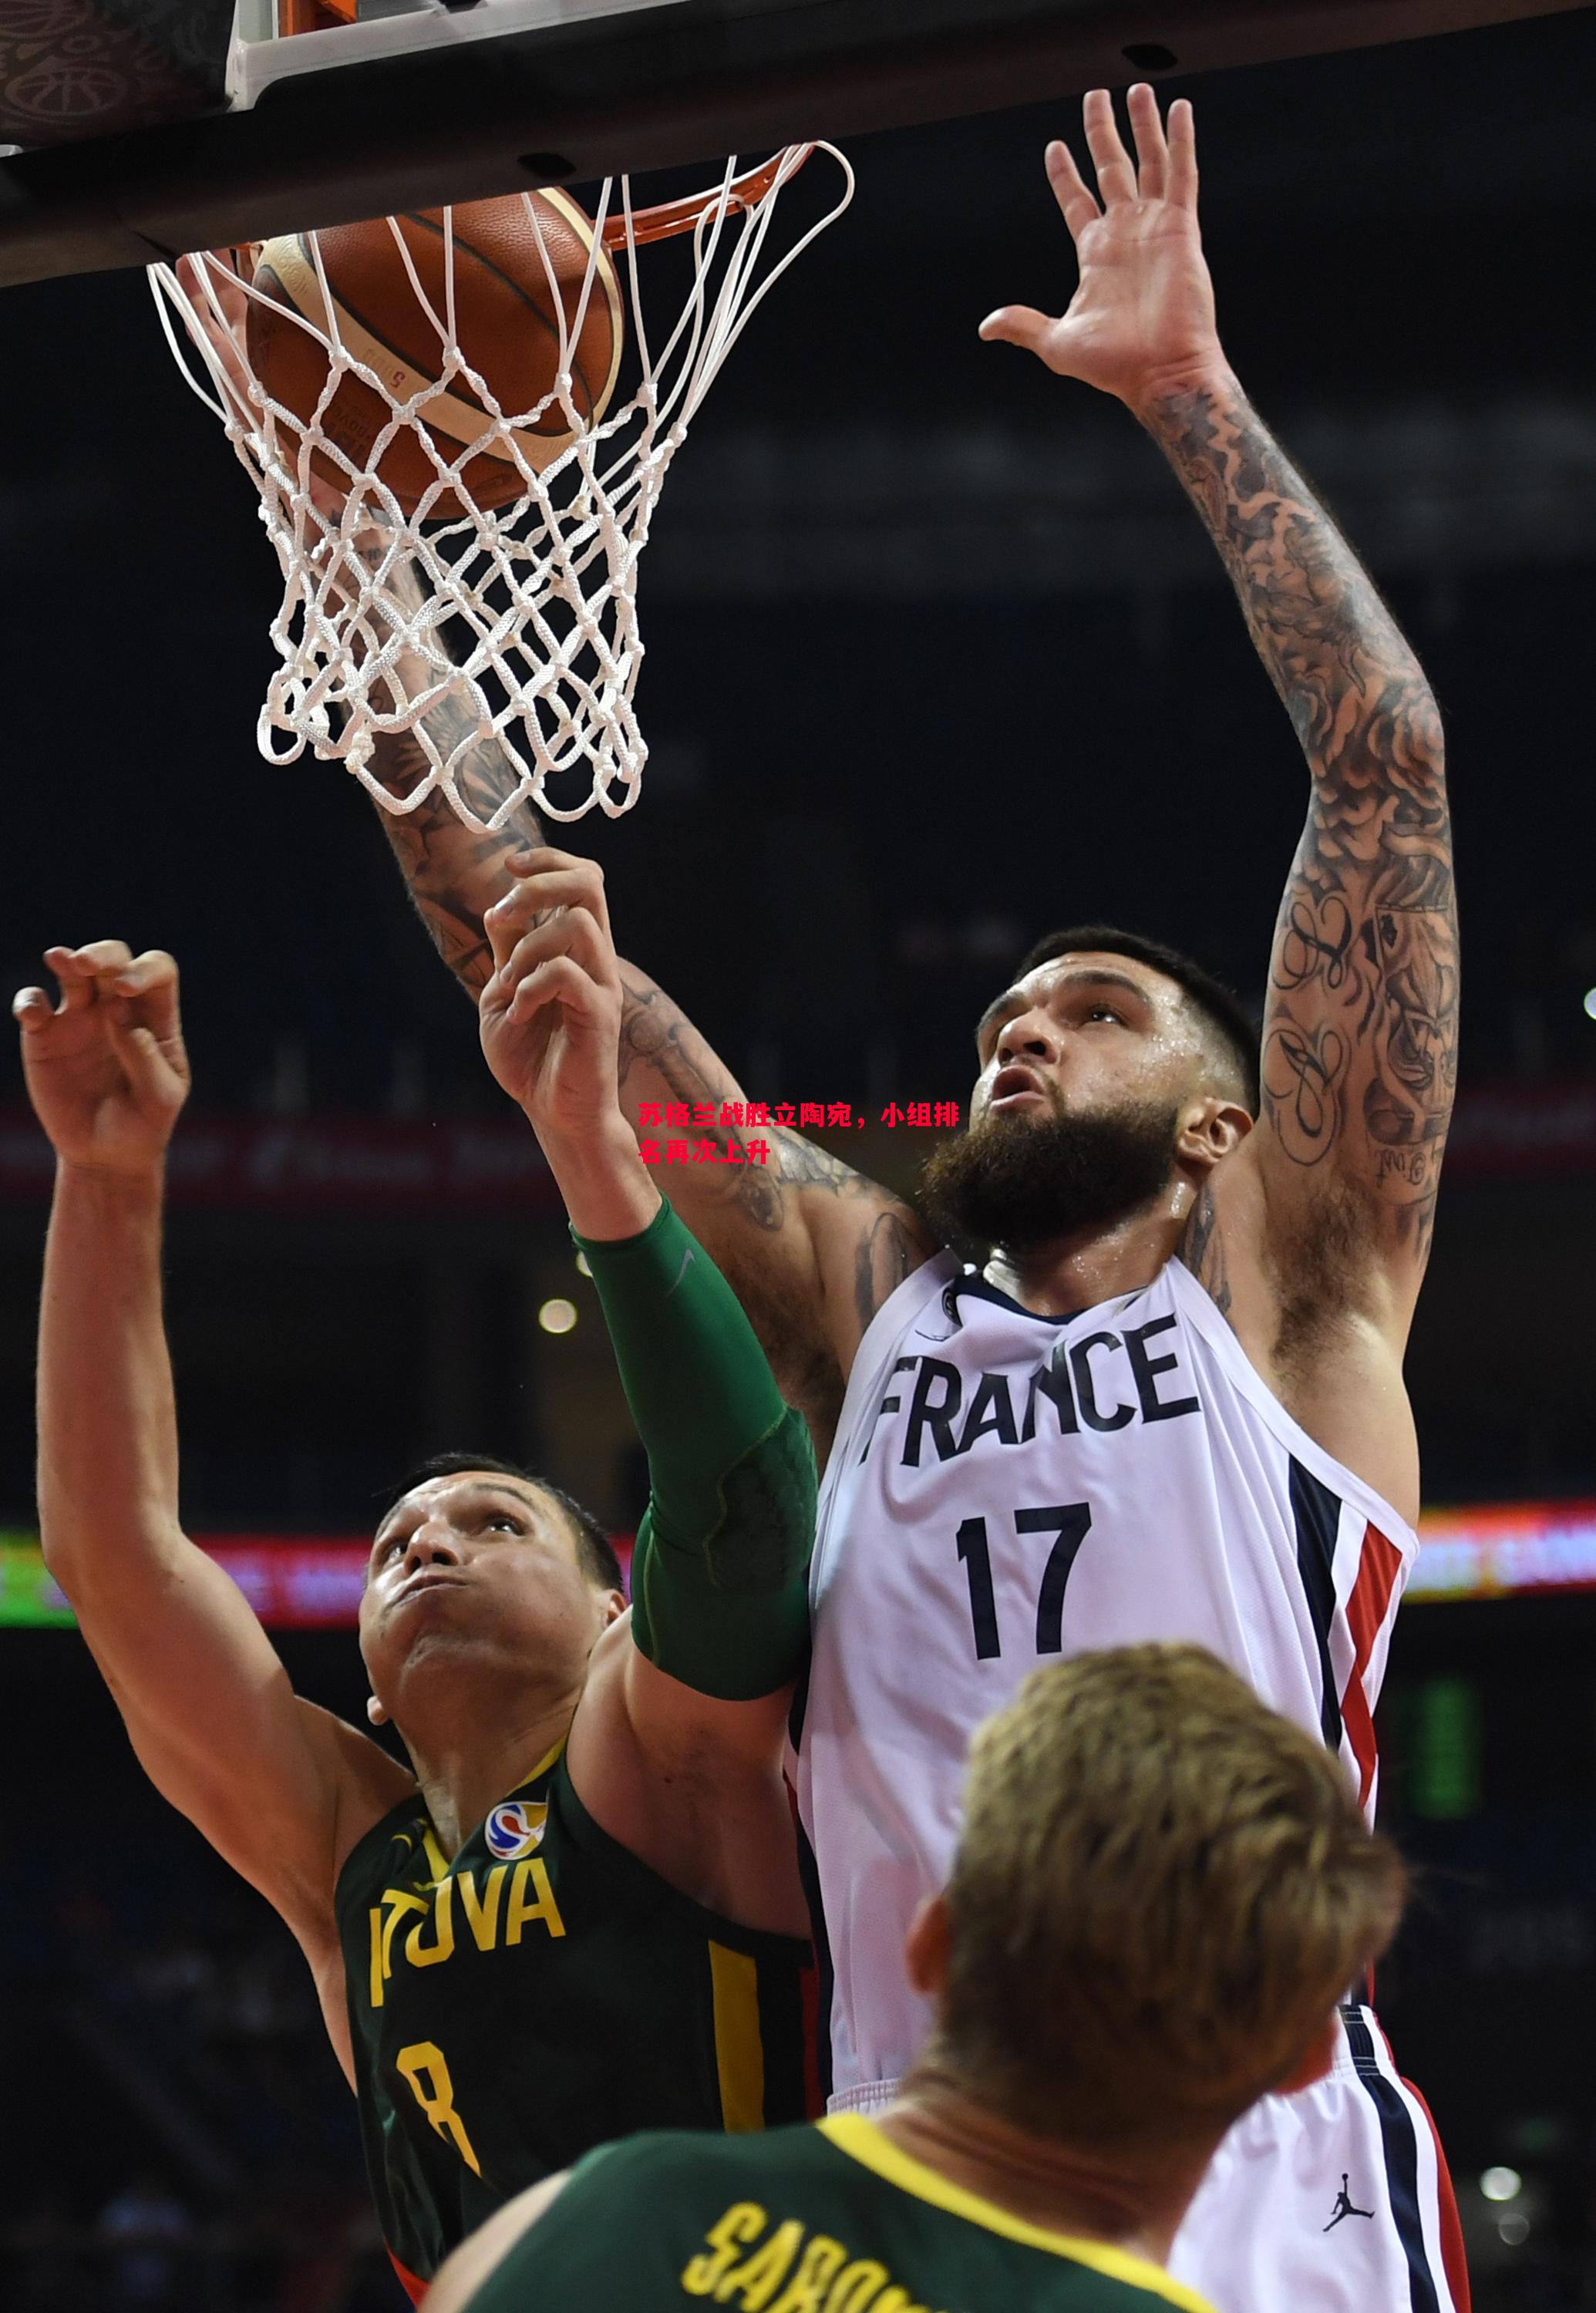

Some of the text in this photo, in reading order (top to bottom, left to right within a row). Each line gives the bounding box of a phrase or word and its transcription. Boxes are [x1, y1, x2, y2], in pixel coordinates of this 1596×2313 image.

[857, 1313, 1201, 1468] FRANCE
[955, 1501, 1093, 1662] 17
[396, 2041, 482, 2178] 8
